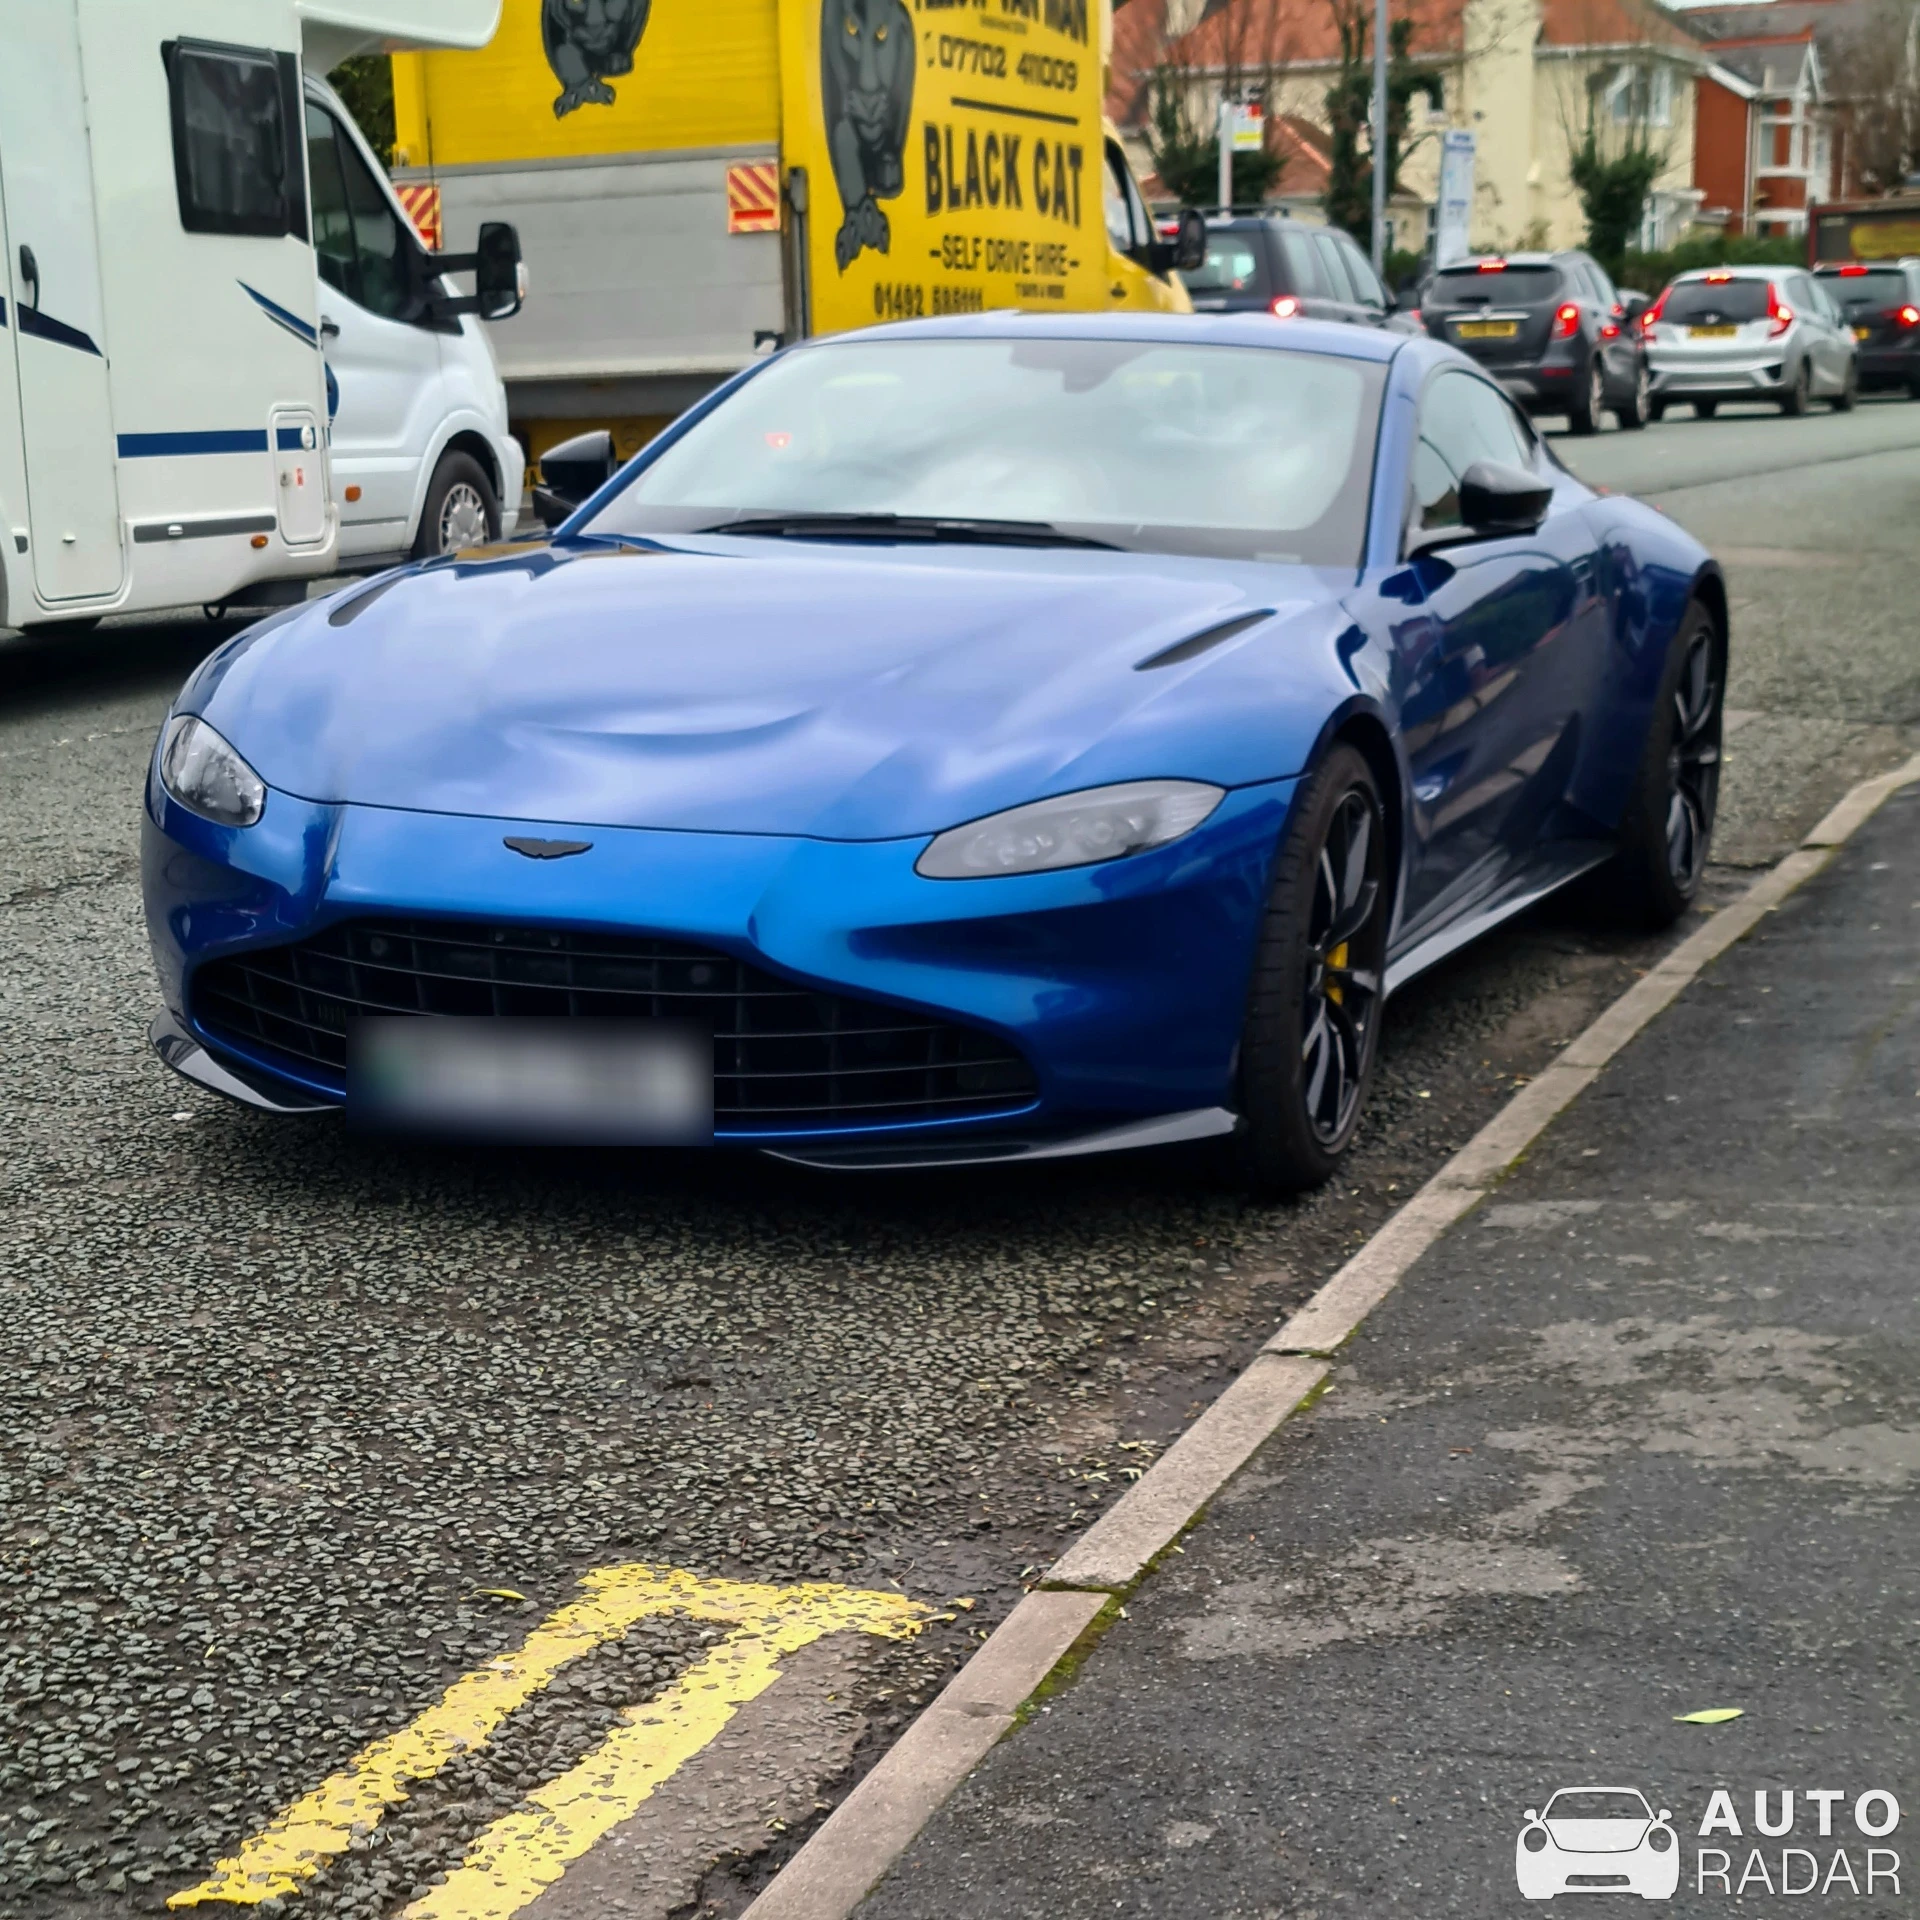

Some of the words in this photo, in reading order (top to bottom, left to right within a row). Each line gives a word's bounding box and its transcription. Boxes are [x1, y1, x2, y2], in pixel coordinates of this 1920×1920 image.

[939, 34, 1007, 79] 07702
[923, 121, 1023, 218] BLACK
[1033, 137, 1083, 230] CAT
[986, 238, 1031, 274] DRIVE
[874, 282, 924, 319] 01492
